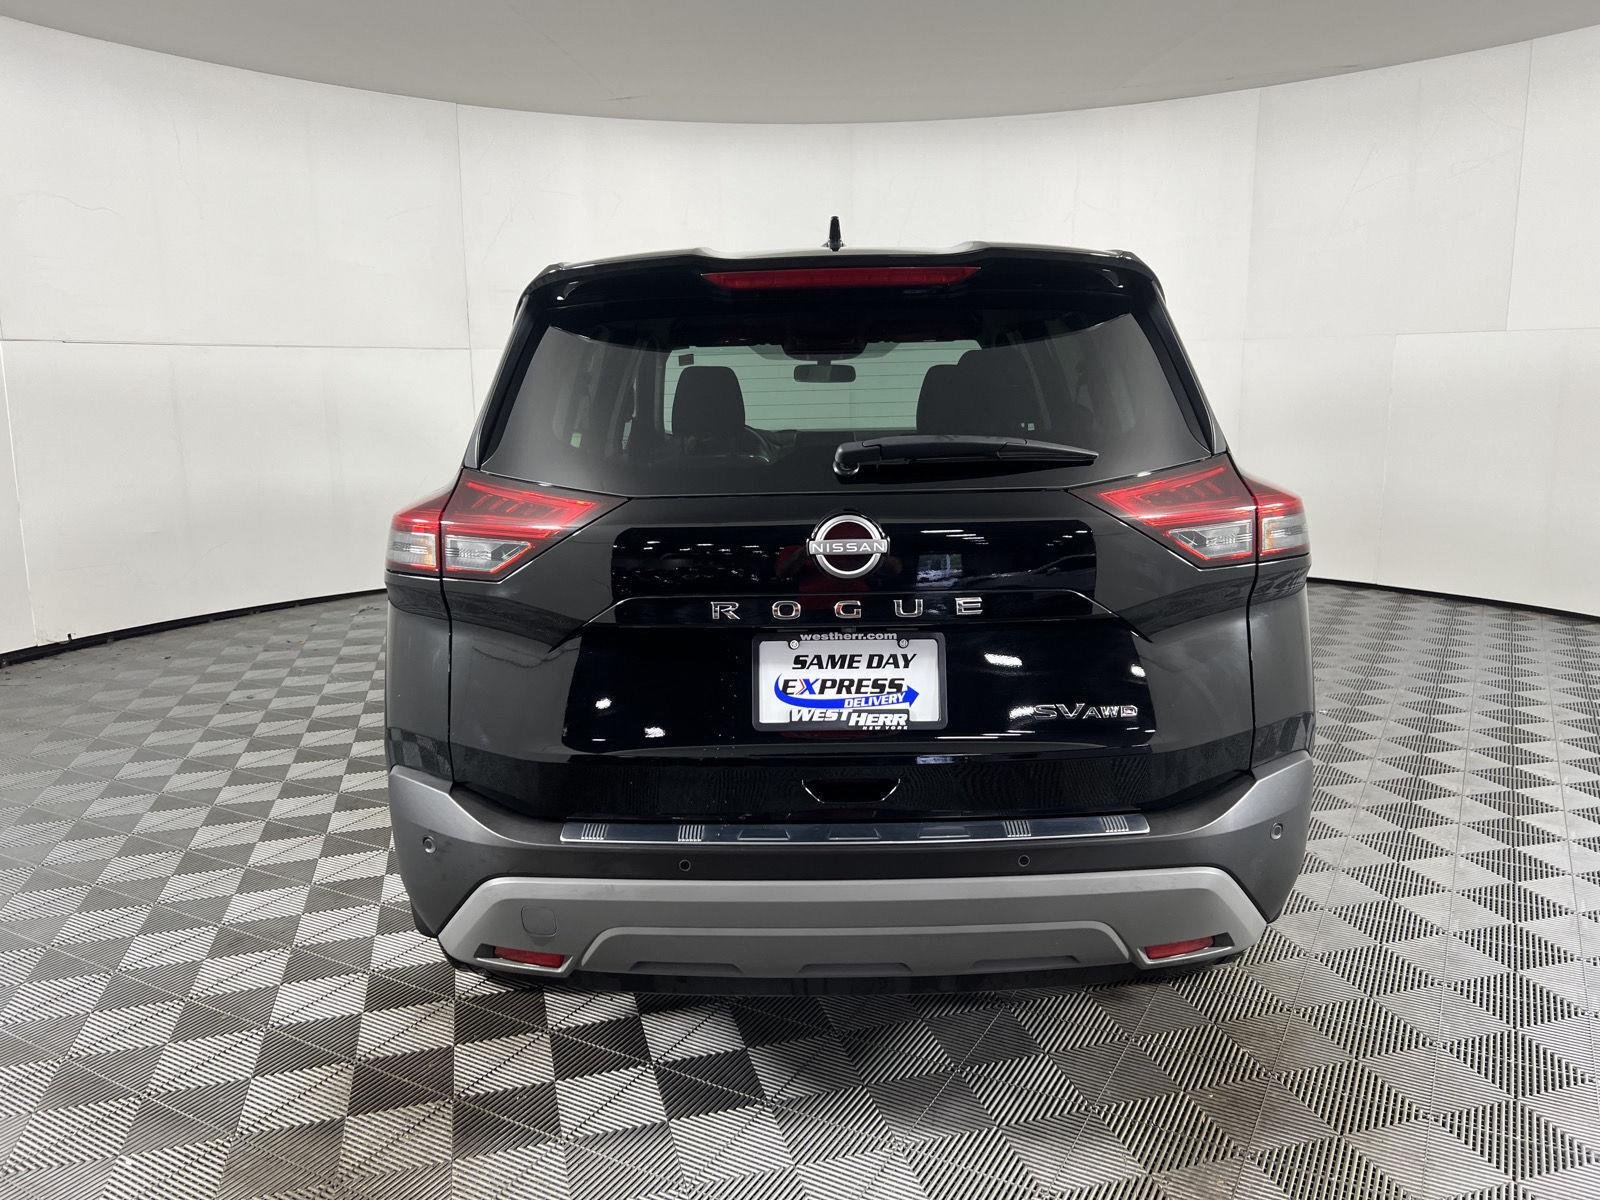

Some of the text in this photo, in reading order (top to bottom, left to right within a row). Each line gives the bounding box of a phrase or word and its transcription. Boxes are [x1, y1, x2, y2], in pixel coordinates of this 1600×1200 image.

[812, 542, 885, 553] NISSAN
[711, 596, 984, 620] ROGUE
[800, 632, 897, 641] westherr.com
[792, 653, 917, 670] SAME DAY
[781, 678, 905, 695] EXPRESS
[844, 692, 906, 708] DELIVERY
